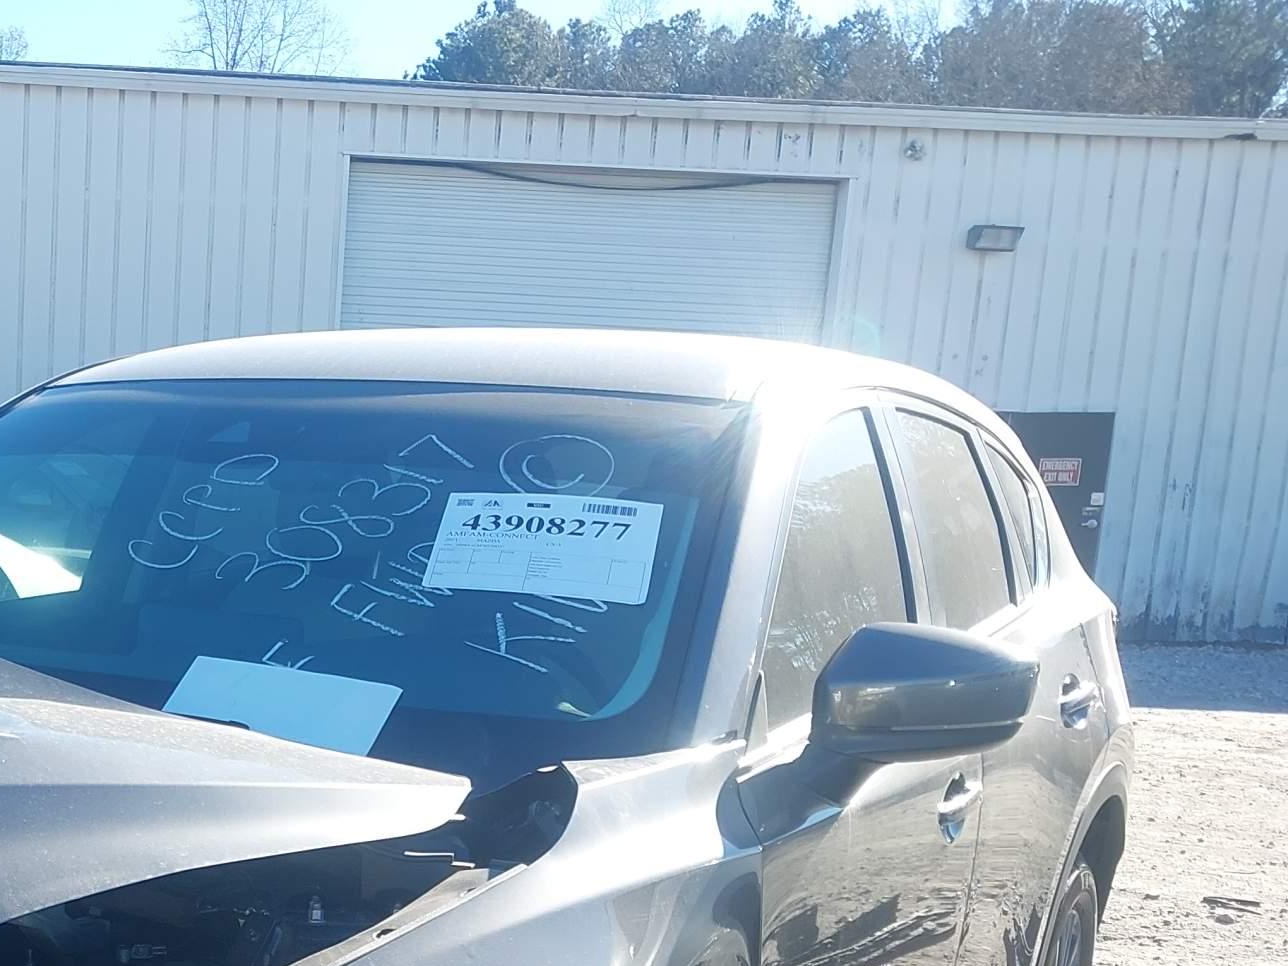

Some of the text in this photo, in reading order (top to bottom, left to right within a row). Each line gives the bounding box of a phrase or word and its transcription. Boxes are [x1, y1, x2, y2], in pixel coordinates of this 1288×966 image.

[1042, 460, 1079, 471] EMERGENCY
[1044, 471, 1074, 482] EXIT ONLY
[461, 513, 632, 541] 43908277
